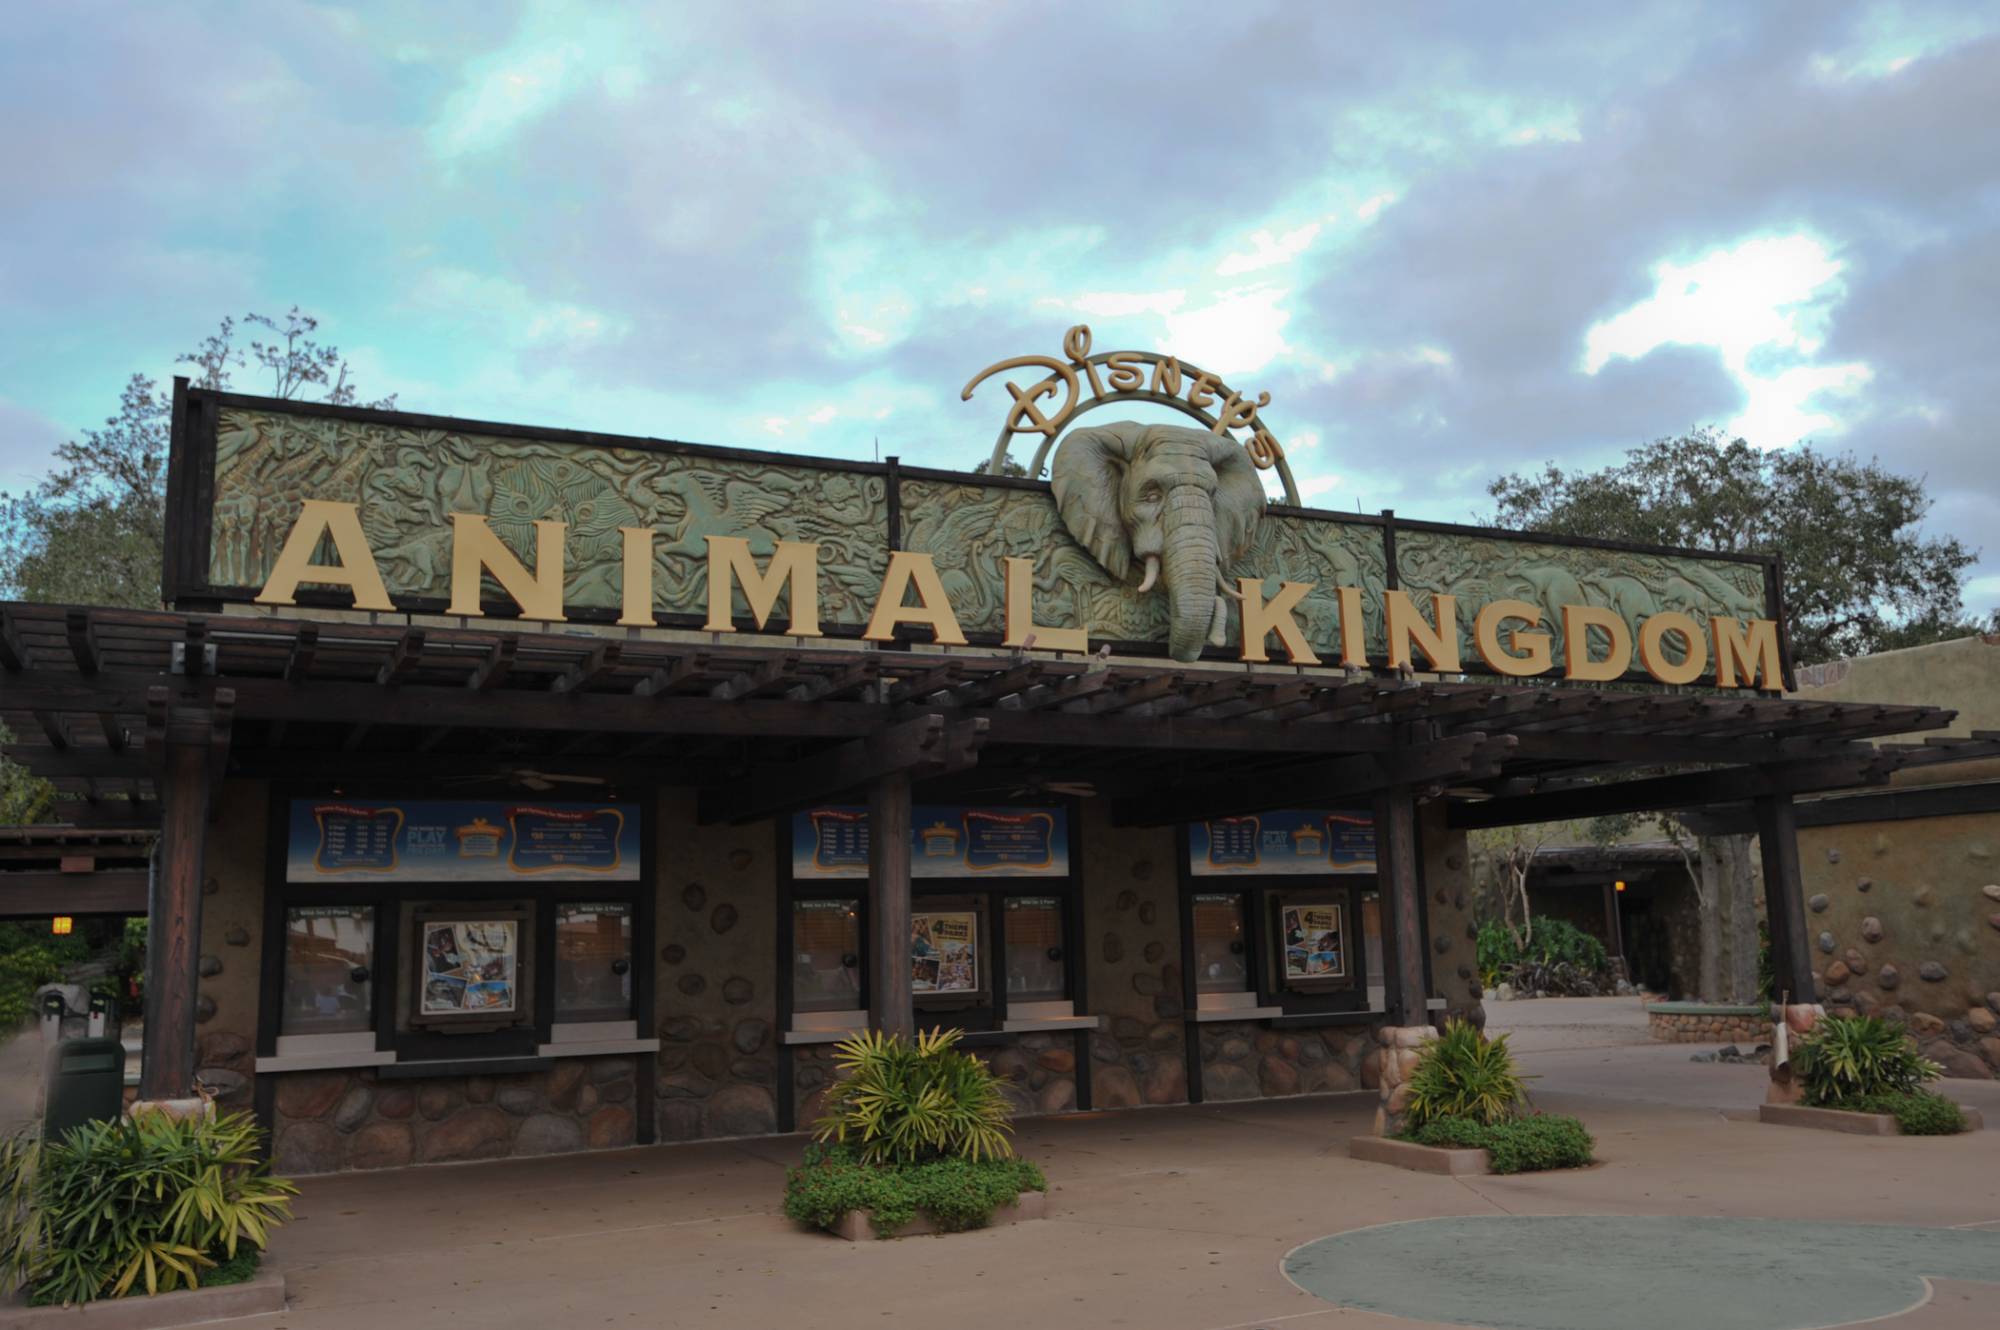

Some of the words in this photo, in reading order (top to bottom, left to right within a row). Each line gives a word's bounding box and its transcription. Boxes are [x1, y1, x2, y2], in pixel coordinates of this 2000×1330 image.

[254, 499, 1089, 654] ANIMAL
[1236, 577, 1785, 692] KINGDOM
[407, 831, 446, 844] PLAY
[1263, 832, 1287, 844] PLAY
[1303, 911, 1314, 924] 4
[932, 920, 944, 934] 4
